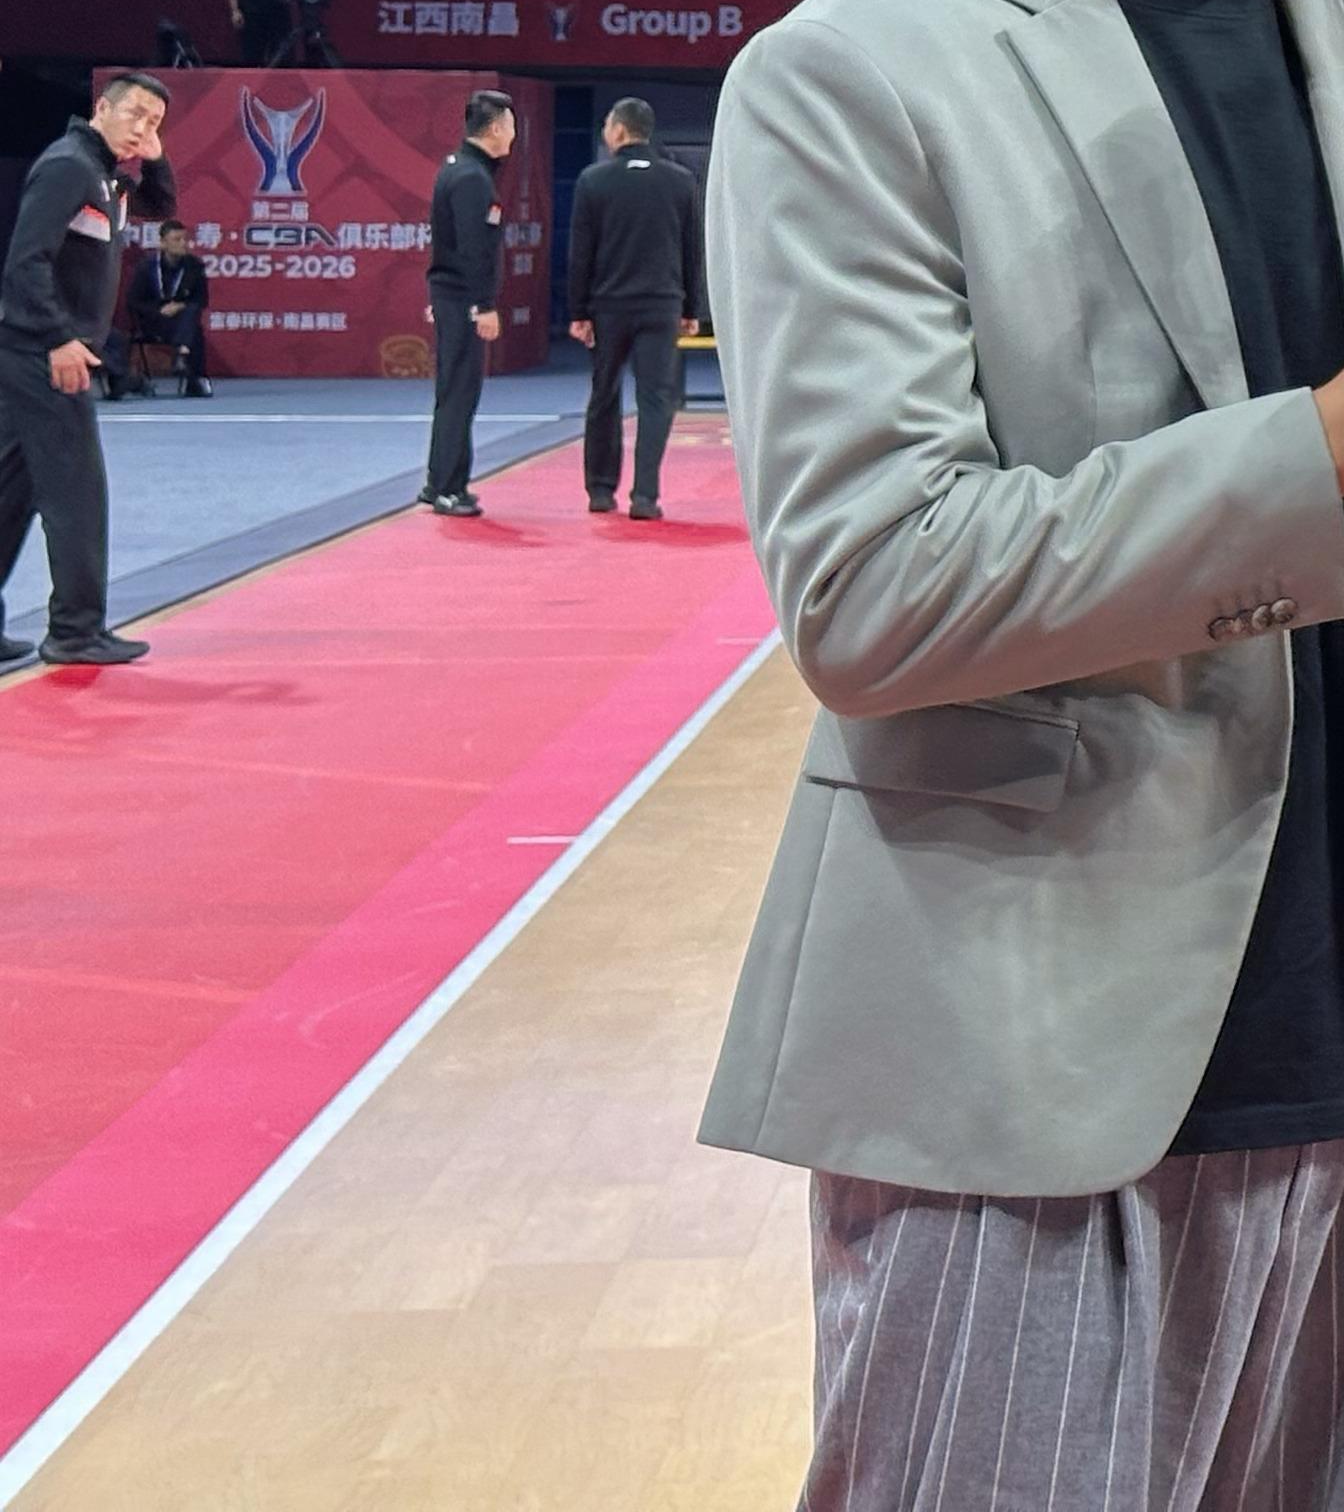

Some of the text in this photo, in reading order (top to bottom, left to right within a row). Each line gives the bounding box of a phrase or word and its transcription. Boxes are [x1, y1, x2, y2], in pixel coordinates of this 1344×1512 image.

[378, 0, 519, 36] 江西南昌
[602, 3, 743, 43] Group B
[251, 200, 309, 222] 第二届
[204, 254, 356, 280] 2025-2026
